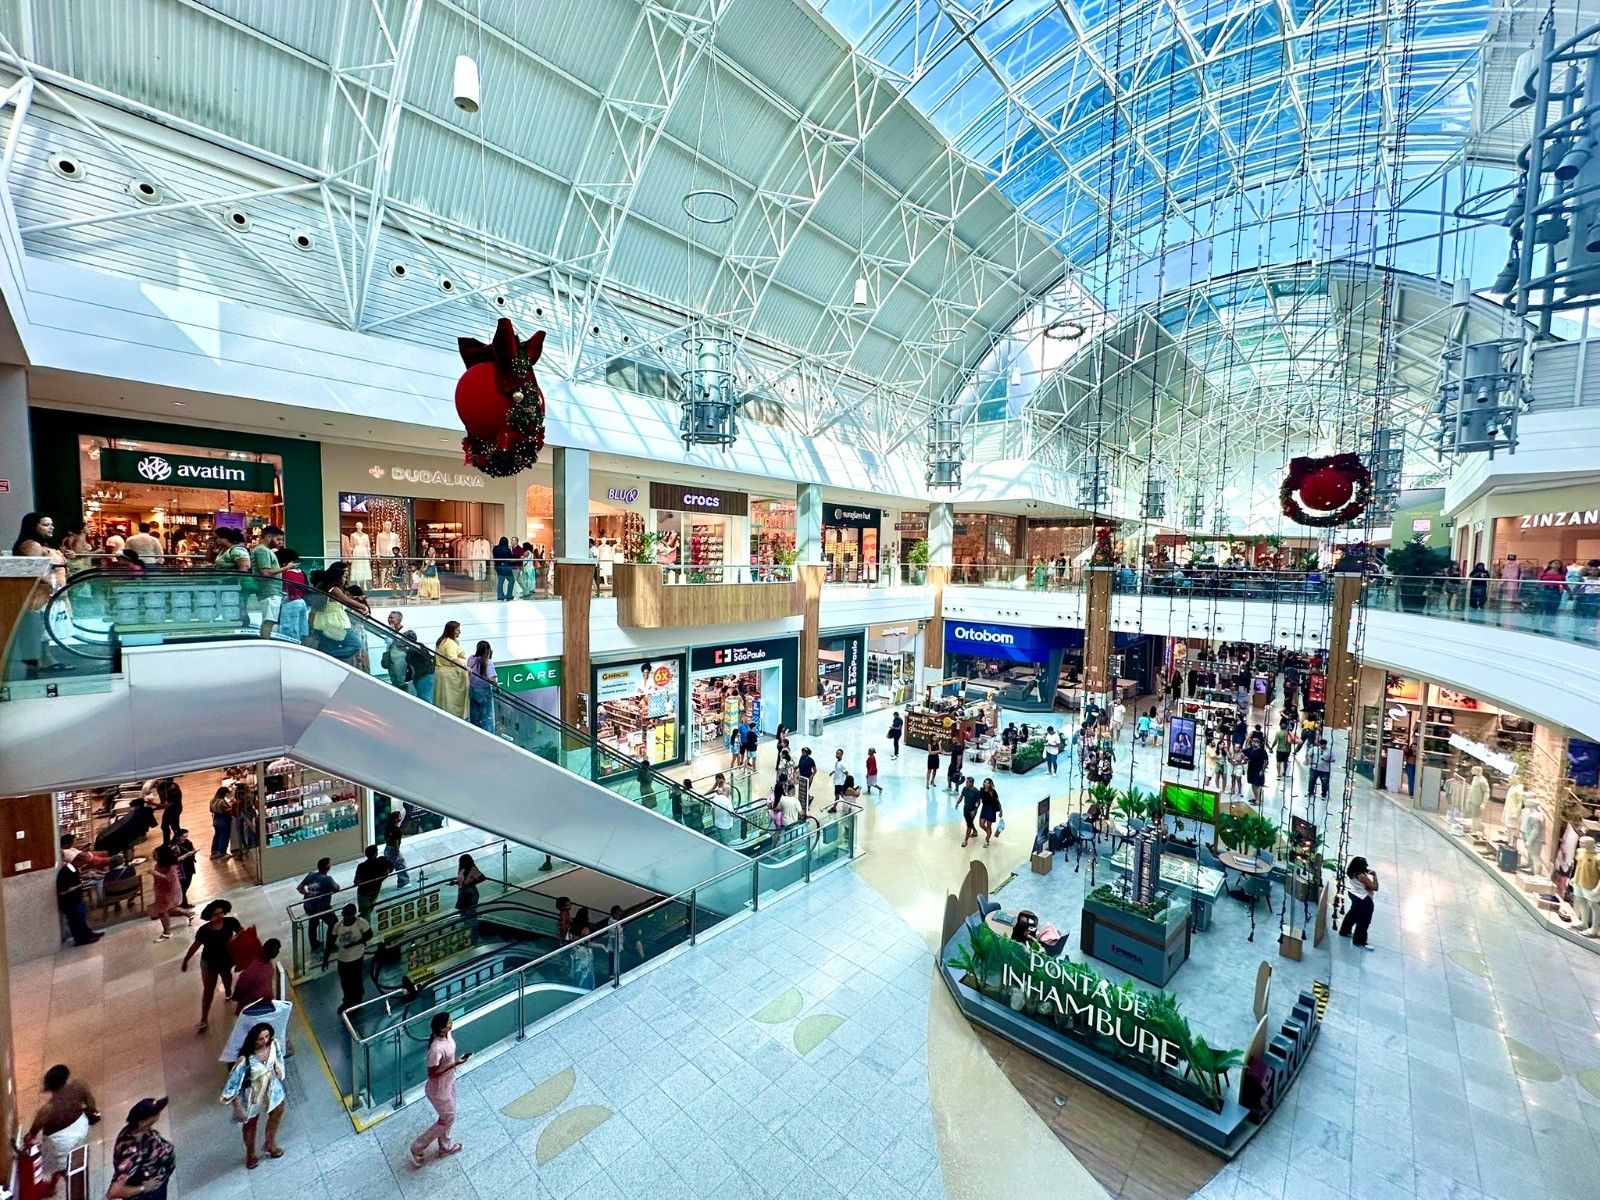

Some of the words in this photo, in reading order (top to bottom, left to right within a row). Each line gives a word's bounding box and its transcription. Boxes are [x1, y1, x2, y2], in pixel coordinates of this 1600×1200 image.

[177, 464, 245, 481] avatim
[391, 467, 484, 487] DUDALINA
[683, 494, 720, 507] crocs
[954, 626, 1014, 644] Ortobom
[513, 669, 556, 683] CARE
[1030, 951, 1112, 1008] PONTA
[1116, 985, 1146, 1021] DE
